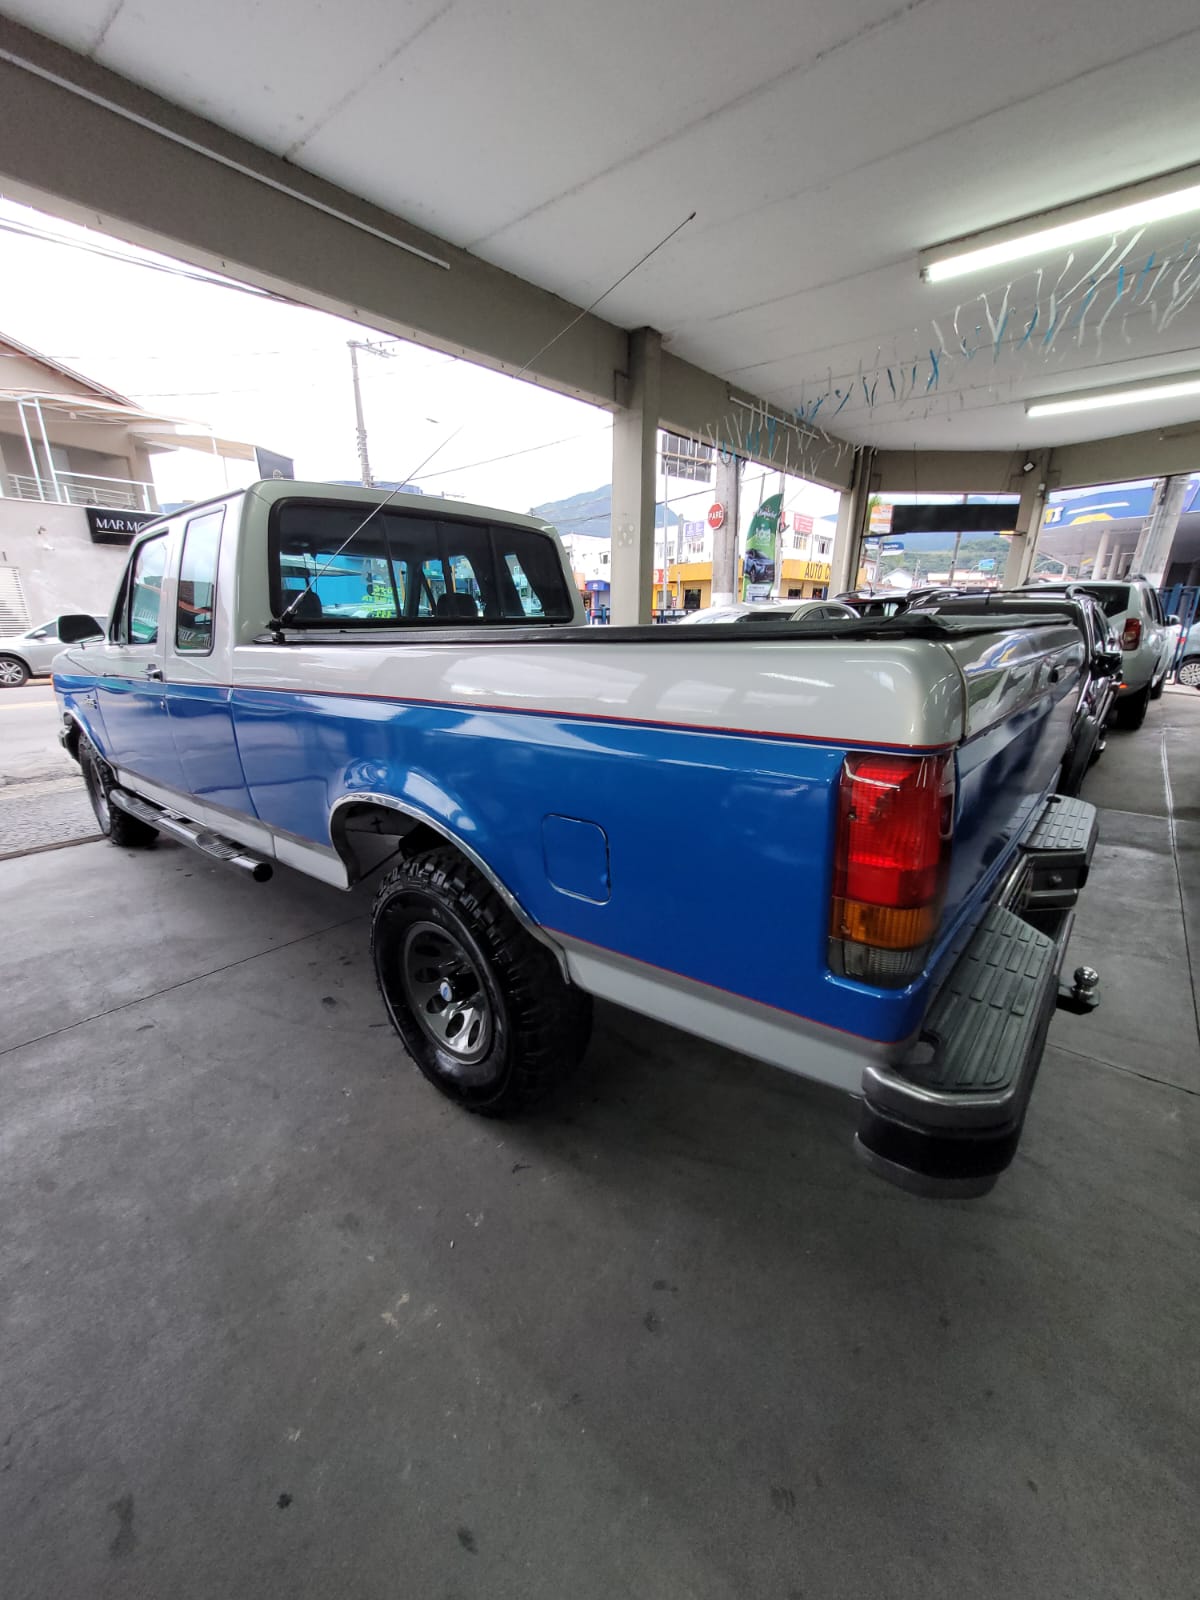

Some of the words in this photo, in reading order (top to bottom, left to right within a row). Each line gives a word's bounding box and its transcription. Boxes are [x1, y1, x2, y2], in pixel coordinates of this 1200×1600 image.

[708, 510, 723, 520] PARE
[95, 518, 124, 531] MAR
[804, 562, 822, 579] AUTO
